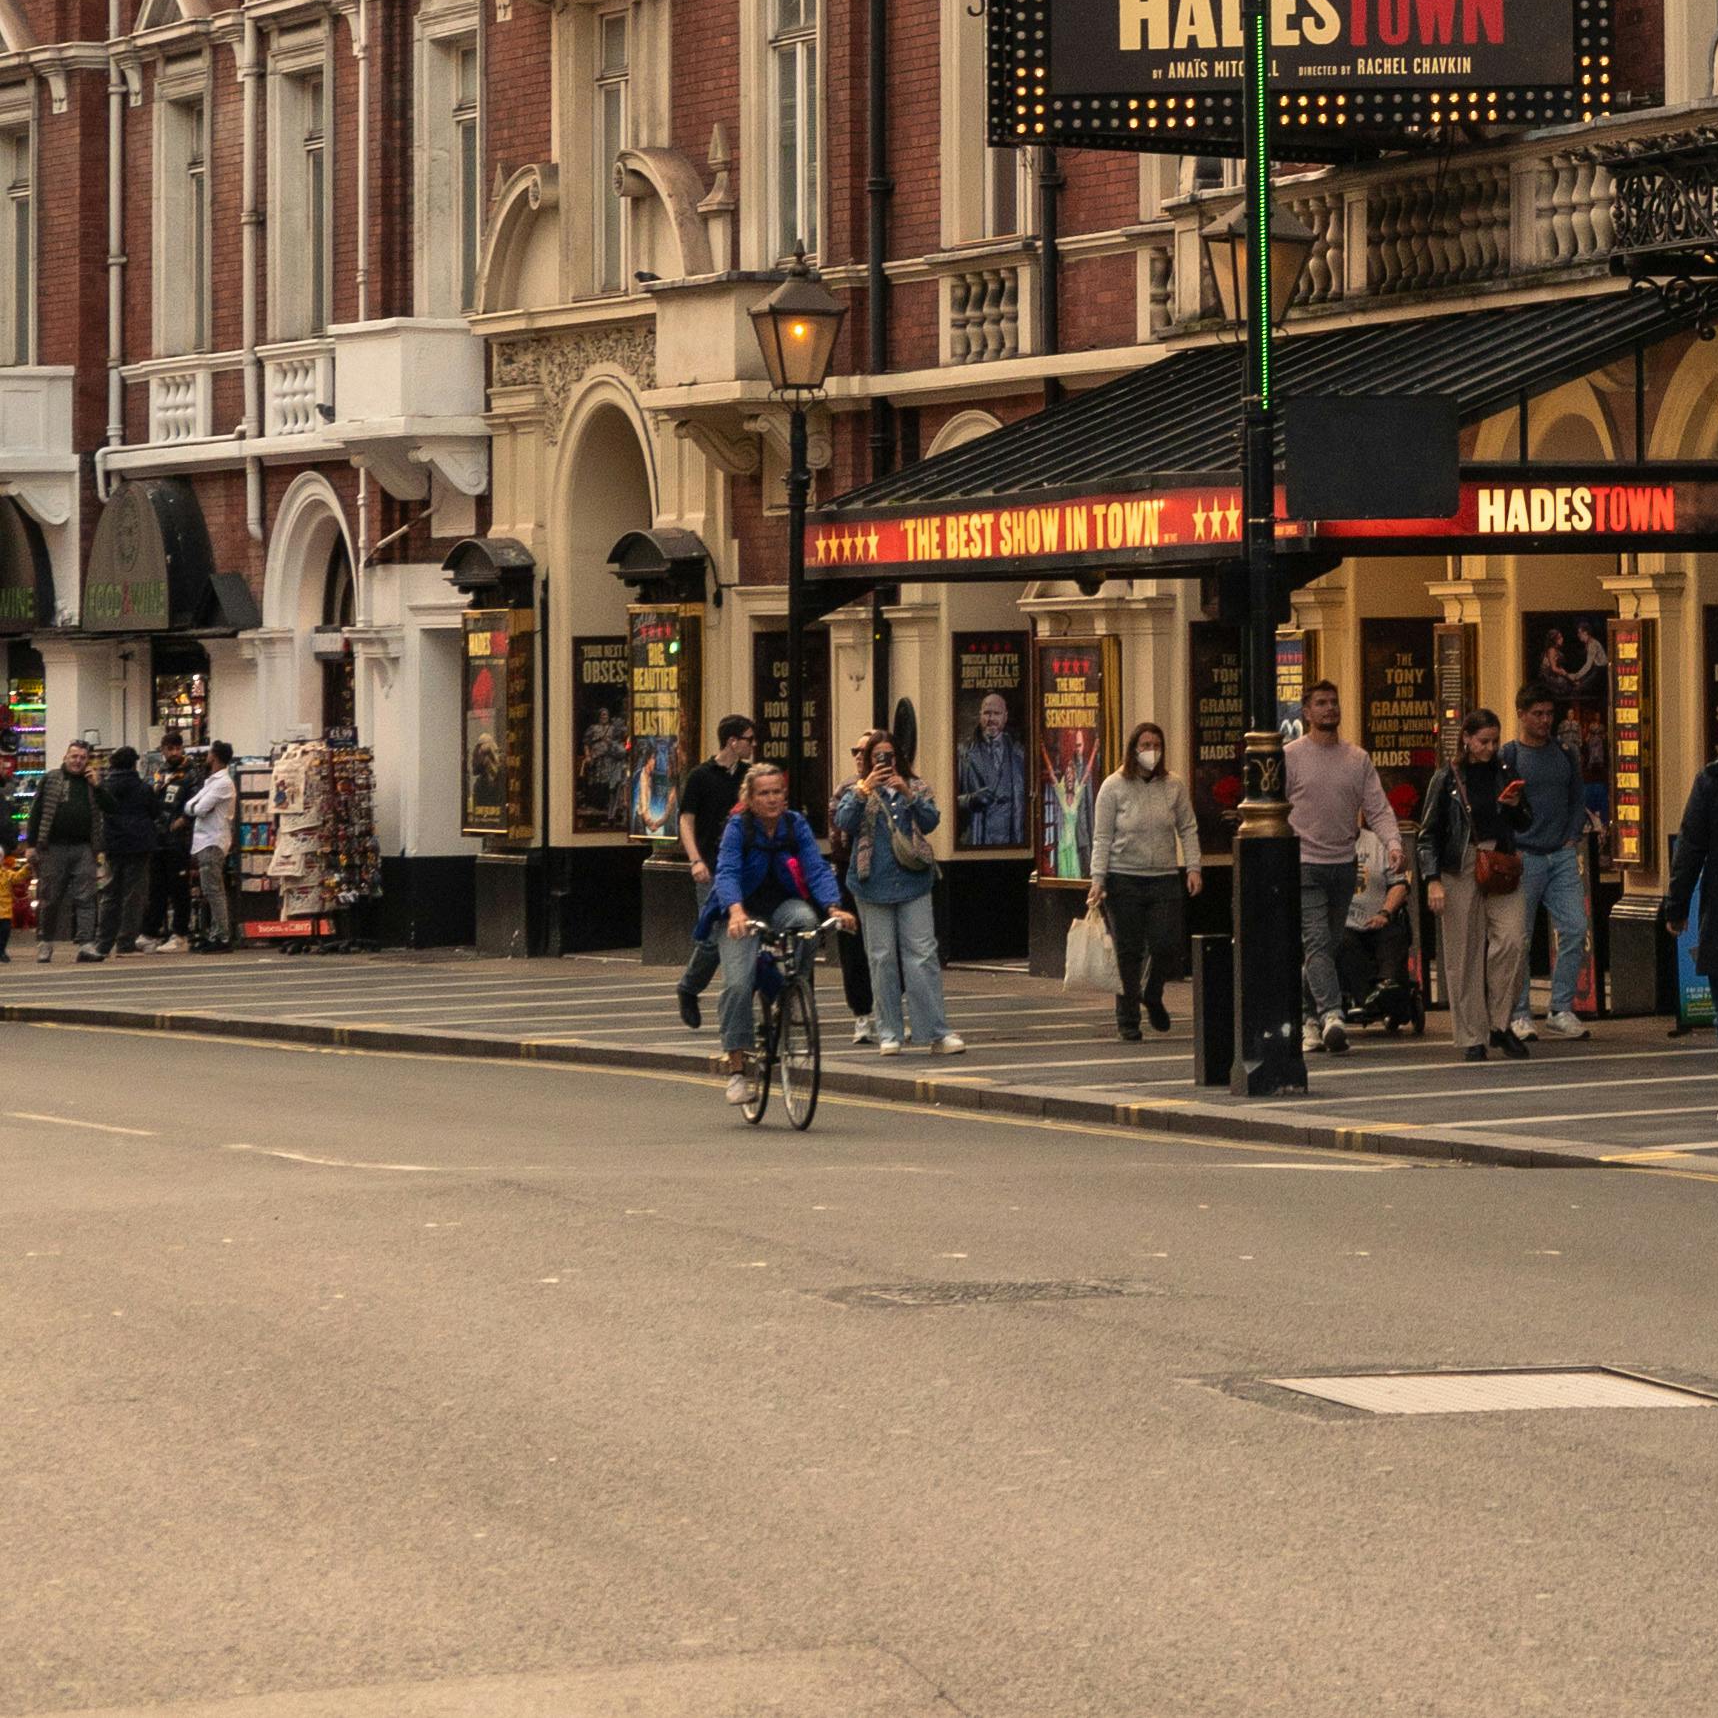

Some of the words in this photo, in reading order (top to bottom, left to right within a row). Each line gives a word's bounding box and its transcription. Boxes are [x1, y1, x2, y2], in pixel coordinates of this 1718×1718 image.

[1152, 68, 1163, 79] BY
[1167, 58, 1209, 79] ANAÏS
[1213, 59, 1280, 79] MITCL
[1298, 65, 1338, 76] DIRECTED
[1340, 65, 1352, 76] BY
[1356, 56, 1408, 76] RACHEL
[1412, 55, 1472, 75] CHAVKIN
[1478, 486, 1675, 534] HADESTOWN
[945, 513, 994, 560] BEST
[999, 507, 1061, 558] SHOW
[1064, 505, 1088, 551] IN
[1384, 668, 1426, 684] TONY
[769, 721, 812, 739] WOD
